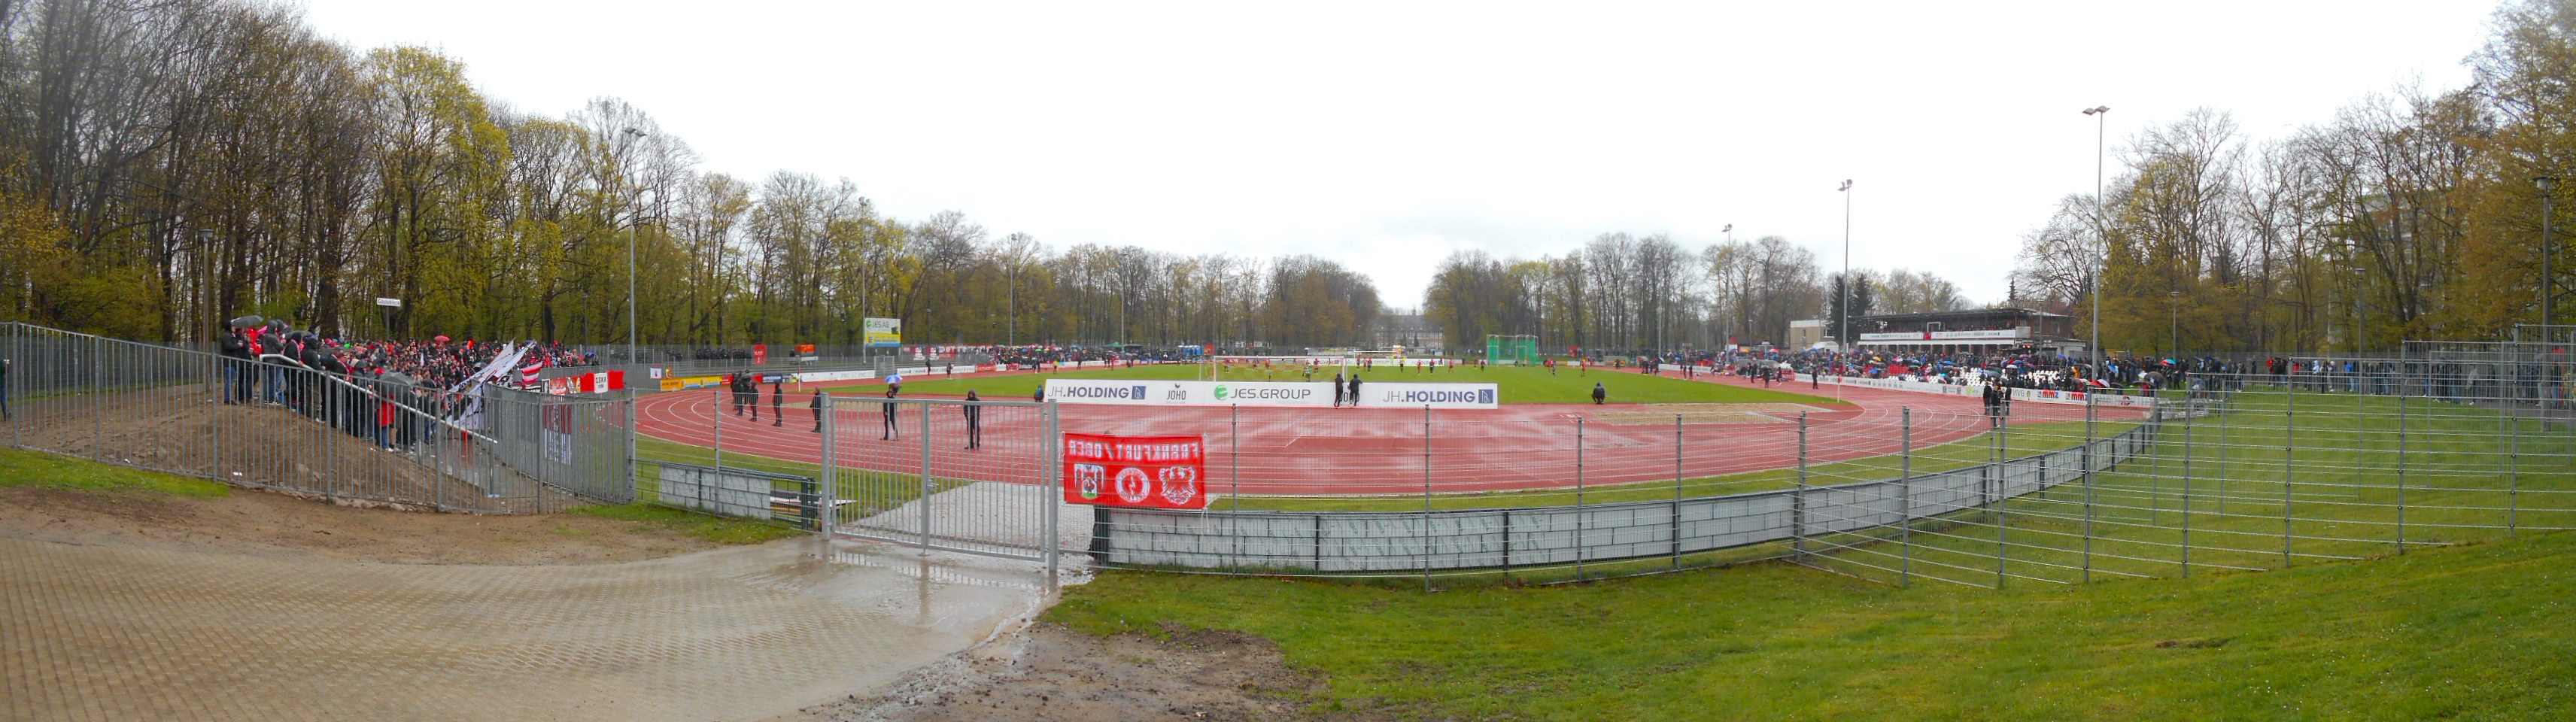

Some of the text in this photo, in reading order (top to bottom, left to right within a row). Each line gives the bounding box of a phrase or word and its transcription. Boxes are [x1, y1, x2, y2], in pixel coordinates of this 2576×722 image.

[1048, 387, 1129, 399] JH.HOLDING
[1166, 390, 1186, 401] JOHO
[1230, 389, 1311, 399] JES.GROUP
[1383, 390, 1476, 403] JH.HOLDING
